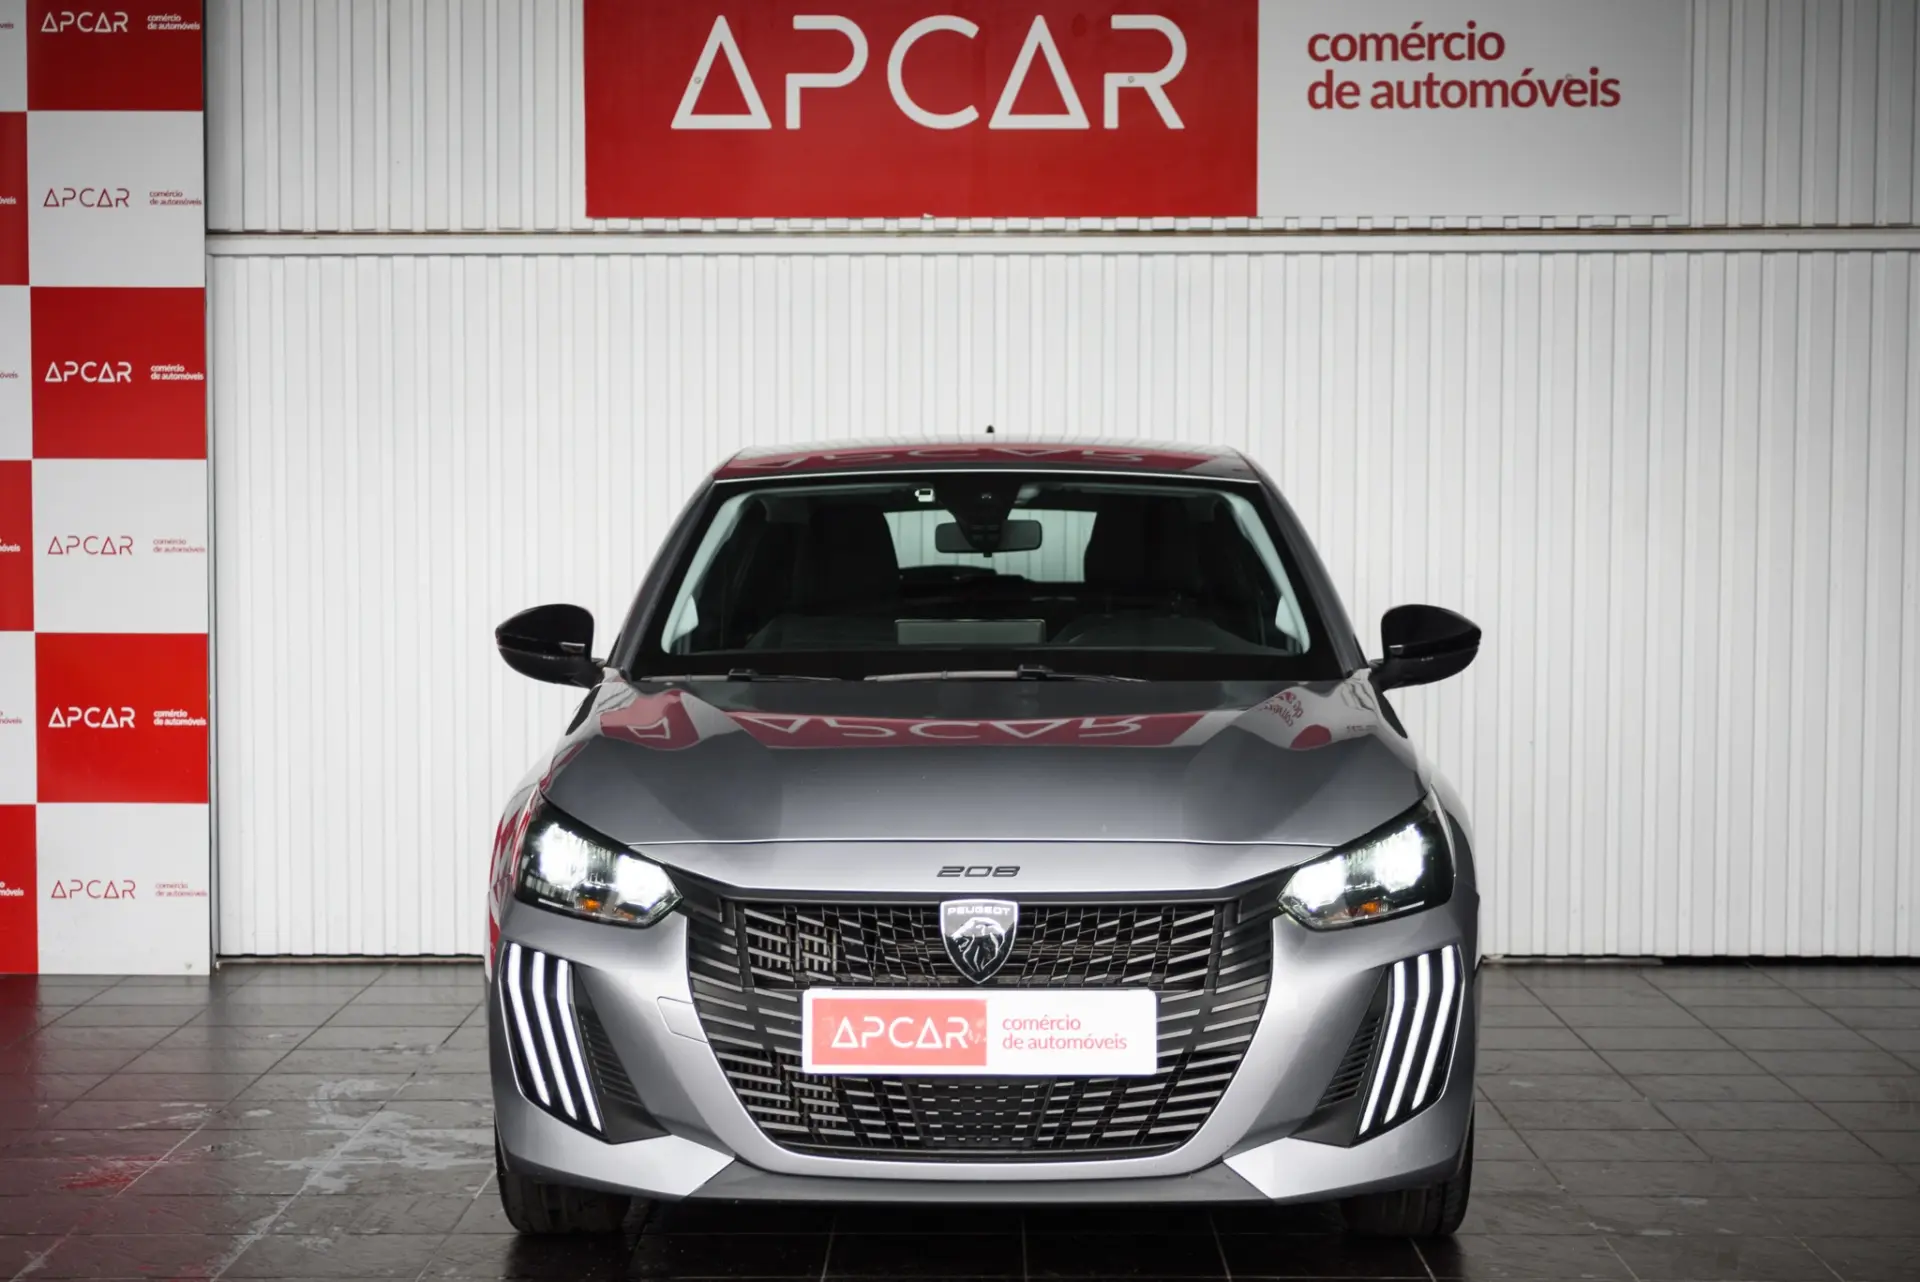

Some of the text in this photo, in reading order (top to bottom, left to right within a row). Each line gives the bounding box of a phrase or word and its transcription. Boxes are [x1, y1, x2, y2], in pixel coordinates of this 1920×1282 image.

[41, 11, 129, 33] APCAR
[147, 13, 182, 22] comércio
[147, 21, 201, 30] de automóveis
[1307, 20, 1506, 62] comércio
[671, 15, 1188, 129] APCAR
[1307, 66, 1622, 110] de automóveis
[43, 187, 130, 208] APCAR
[149, 190, 183, 198] comércio
[149, 198, 159, 206] de
[44, 361, 133, 383] APCAR
[150, 364, 185, 373] comércio
[150, 371, 205, 381] de automóveis
[47, 535, 134, 556] APCAR
[153, 545, 163, 554] de
[48, 706, 136, 729] APCAR
[153, 709, 188, 718] comércio
[153, 716, 207, 727] de automóveis
[936, 865, 1021, 878] 208
[51, 879, 137, 900] APCAR
[947, 905, 1011, 916] PEUGEOT
[831, 1015, 969, 1049] APCAR
[1002, 1014, 1081, 1032] comércio
[1002, 1032, 1128, 1050] de automóveis
